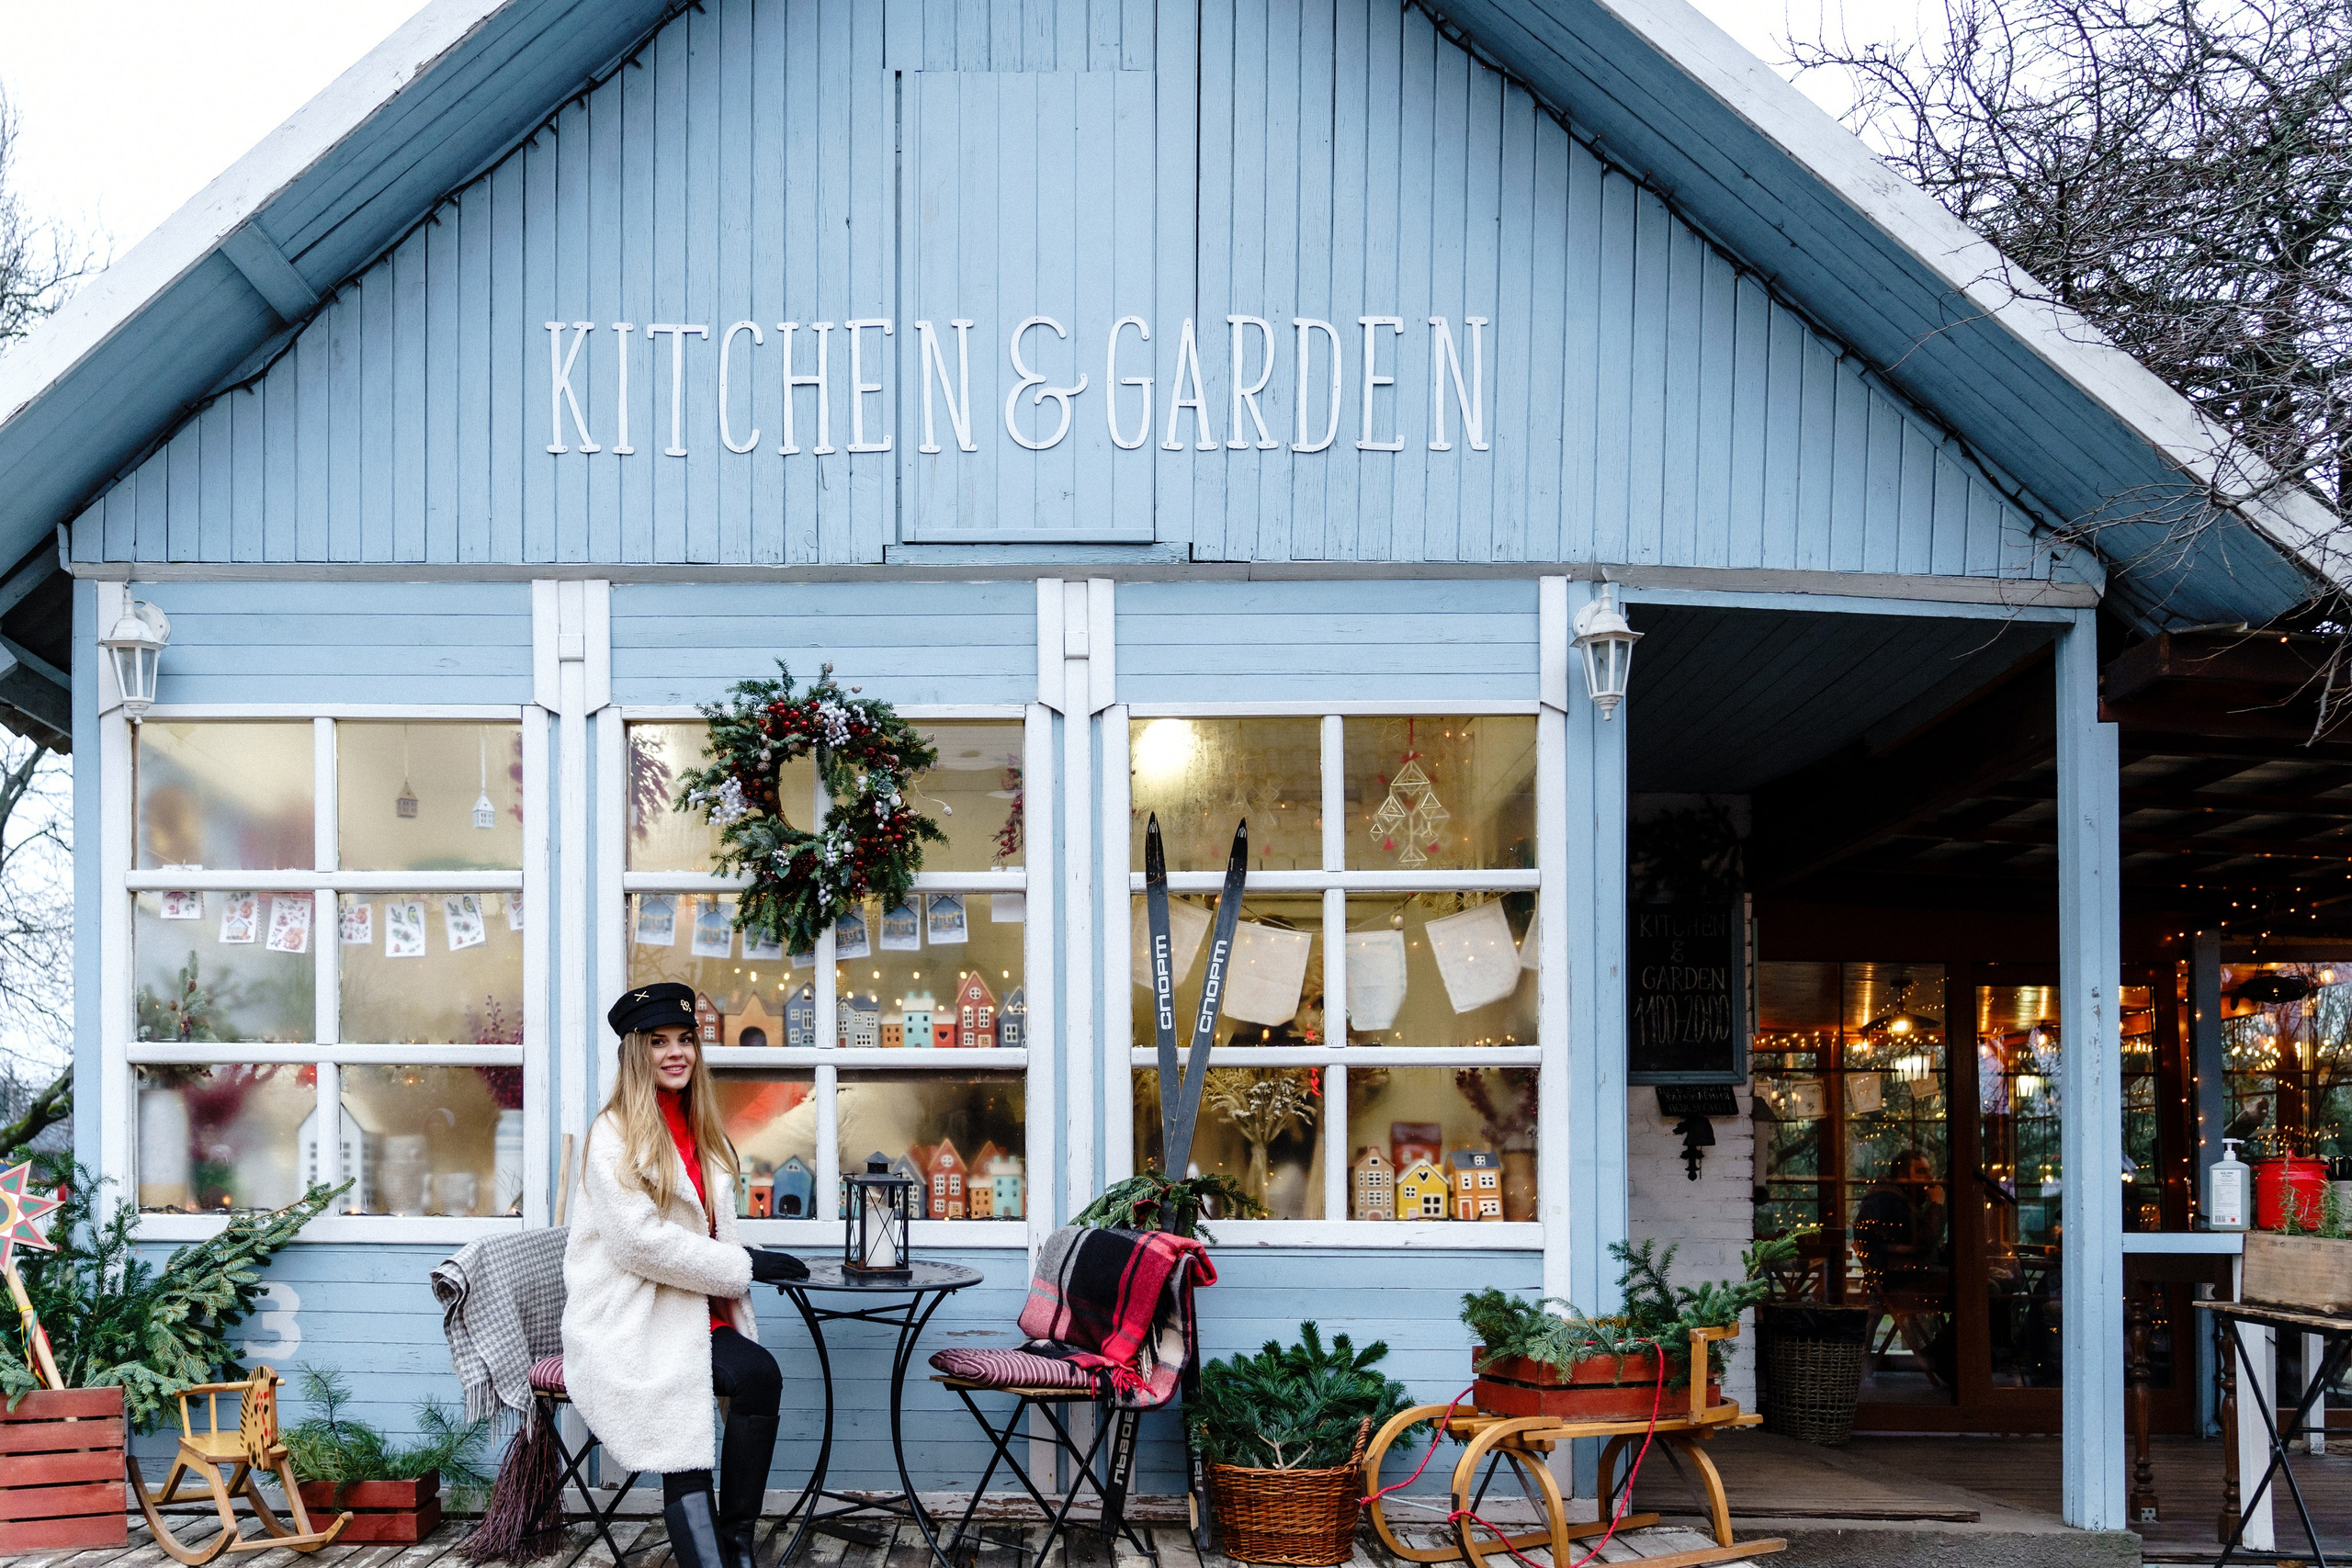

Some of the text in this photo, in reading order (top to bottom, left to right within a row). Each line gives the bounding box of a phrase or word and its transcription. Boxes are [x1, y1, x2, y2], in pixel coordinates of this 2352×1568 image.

[545, 315, 1489, 457] KITCHEN & GARDEN
[1638, 913, 1726, 938] KITCHEN
[1641, 965, 1726, 992] GARDEN
